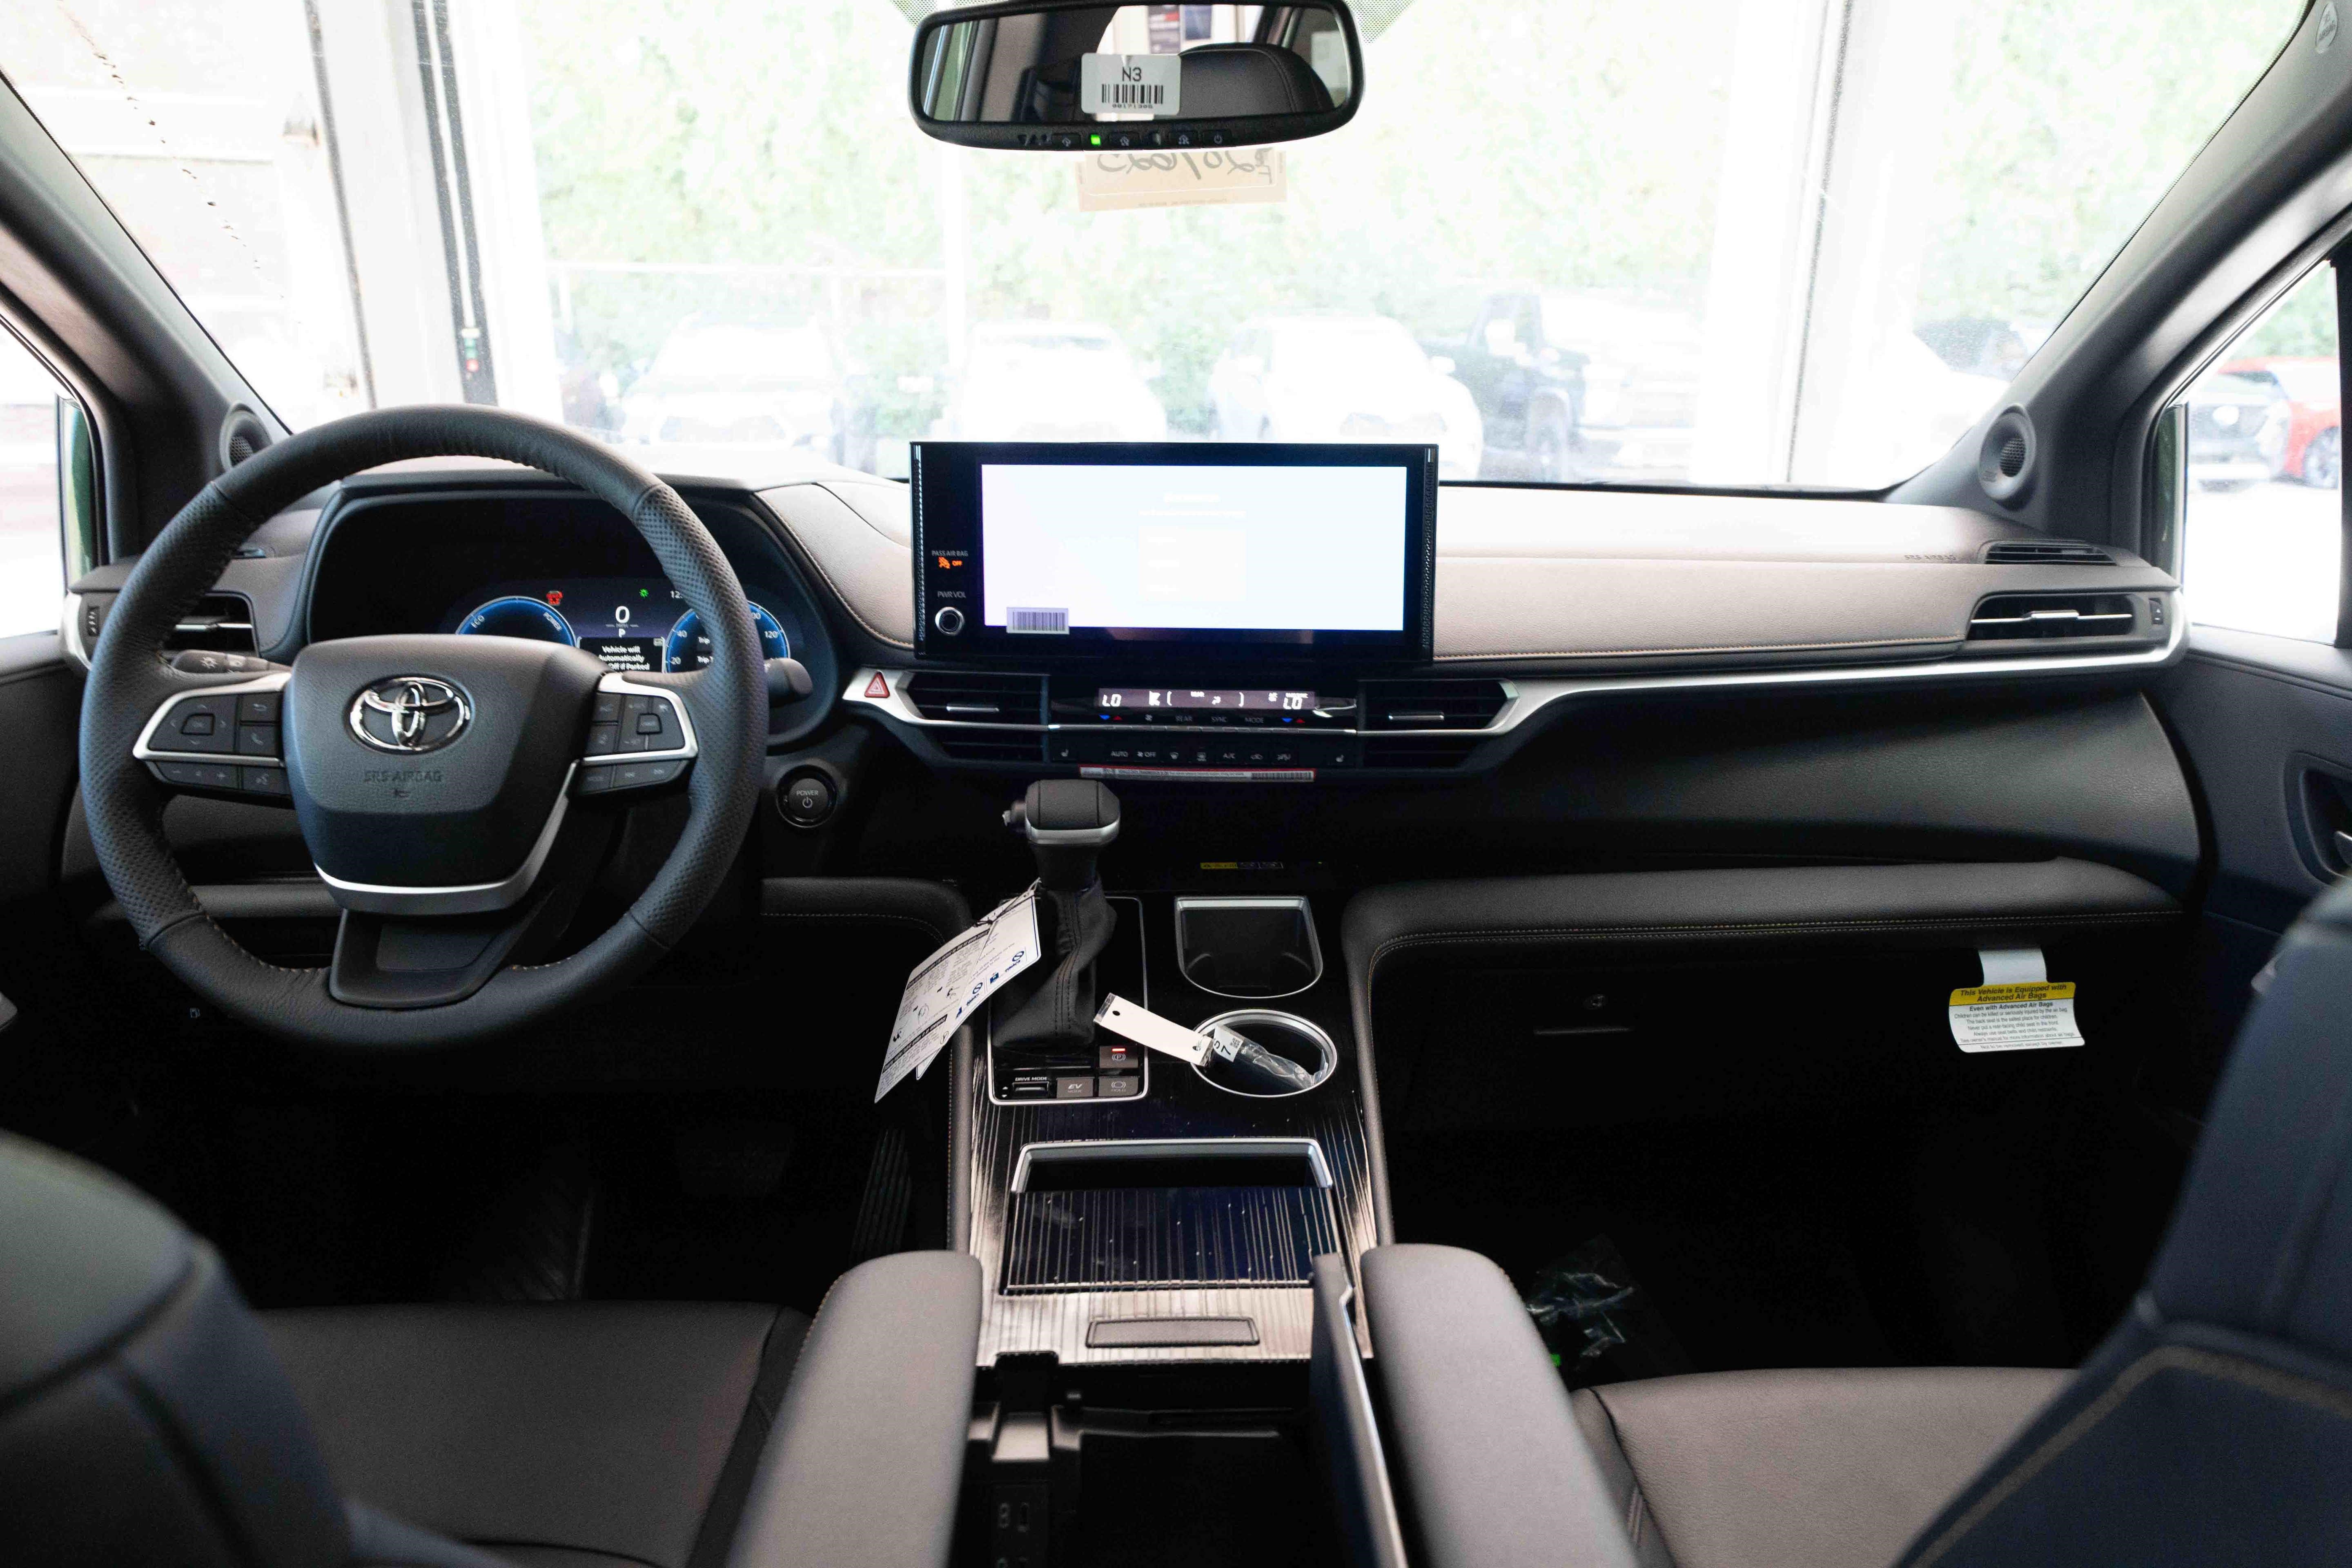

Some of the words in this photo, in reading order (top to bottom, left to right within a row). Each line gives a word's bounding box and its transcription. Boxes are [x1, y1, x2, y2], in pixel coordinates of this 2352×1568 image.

[1122, 67, 1142, 82] N3
[619, 628, 626, 637] P
[2015, 985, 2050, 993] Equipped
